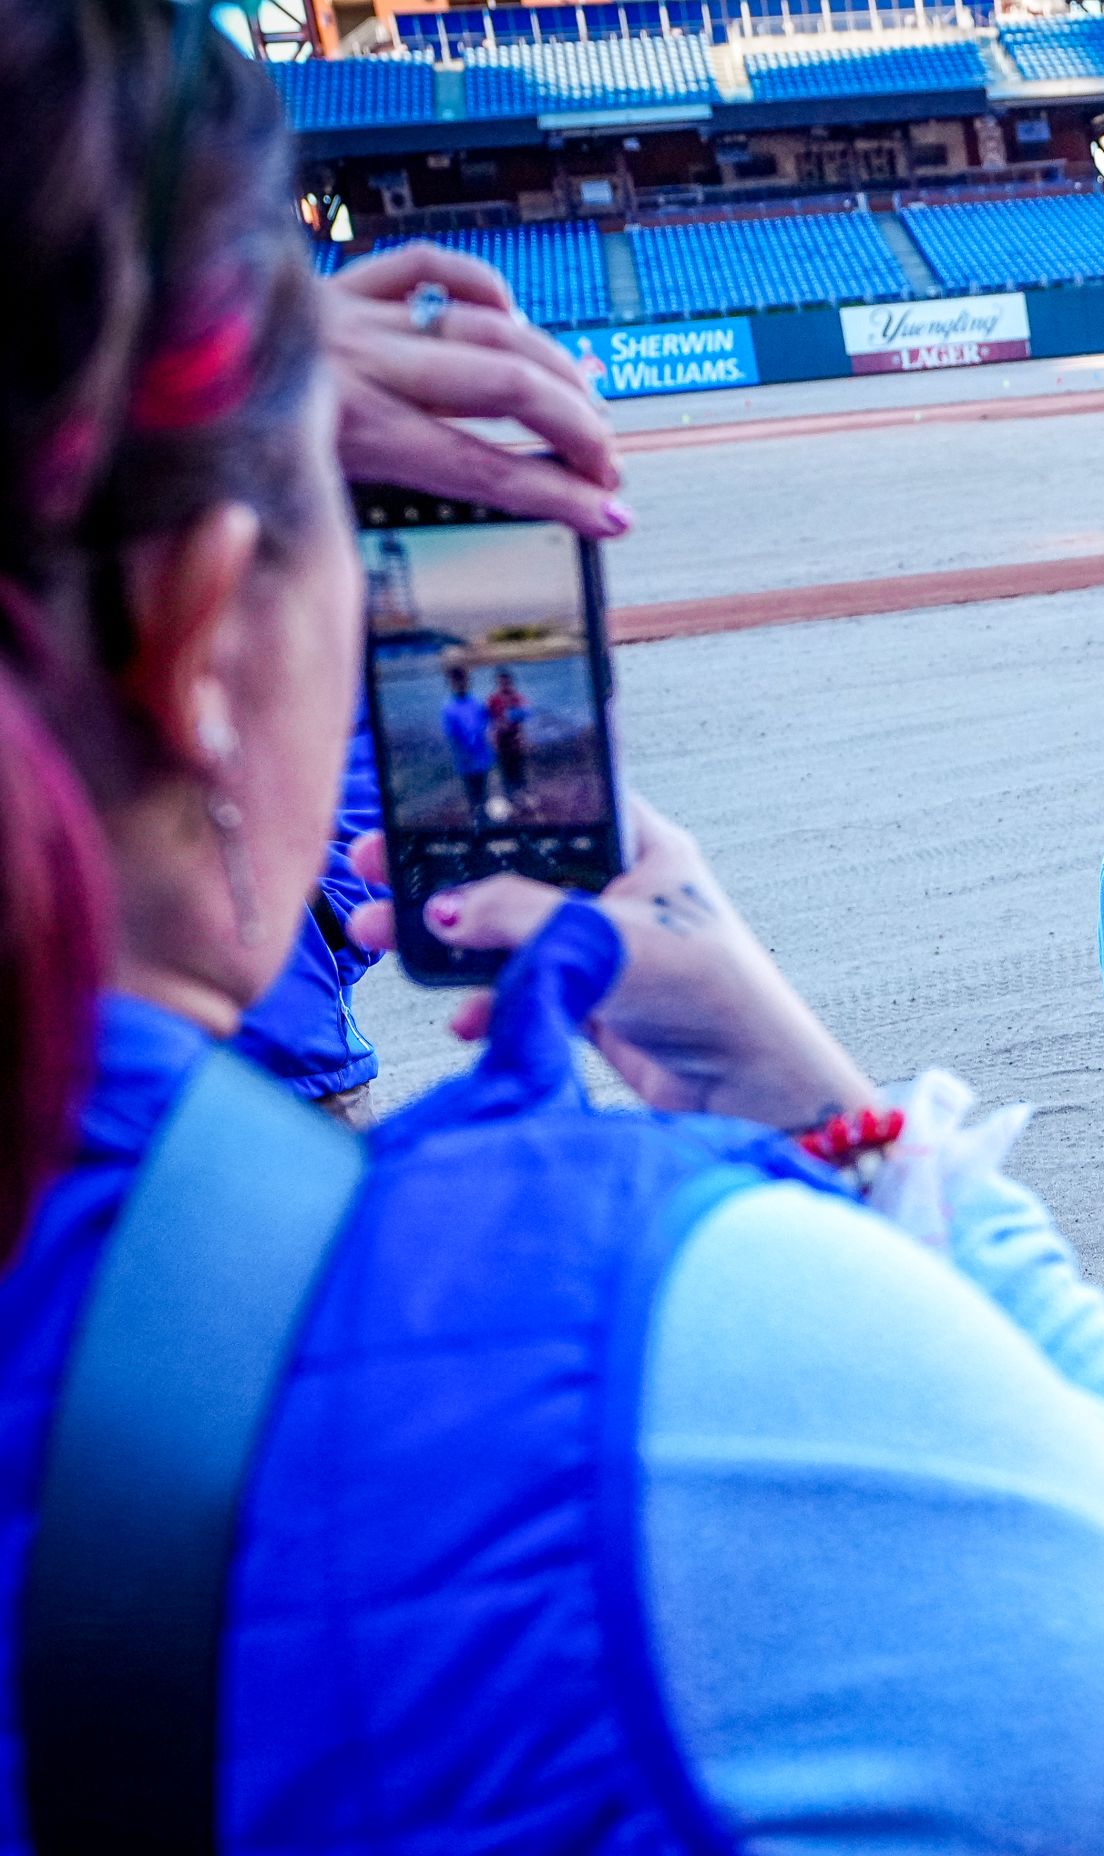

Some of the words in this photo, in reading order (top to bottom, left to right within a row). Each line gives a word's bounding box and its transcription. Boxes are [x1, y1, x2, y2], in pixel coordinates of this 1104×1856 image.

[869, 303, 1002, 346] Yuengling
[611, 328, 735, 362] SHERWIN
[900, 342, 982, 370] LAGER
